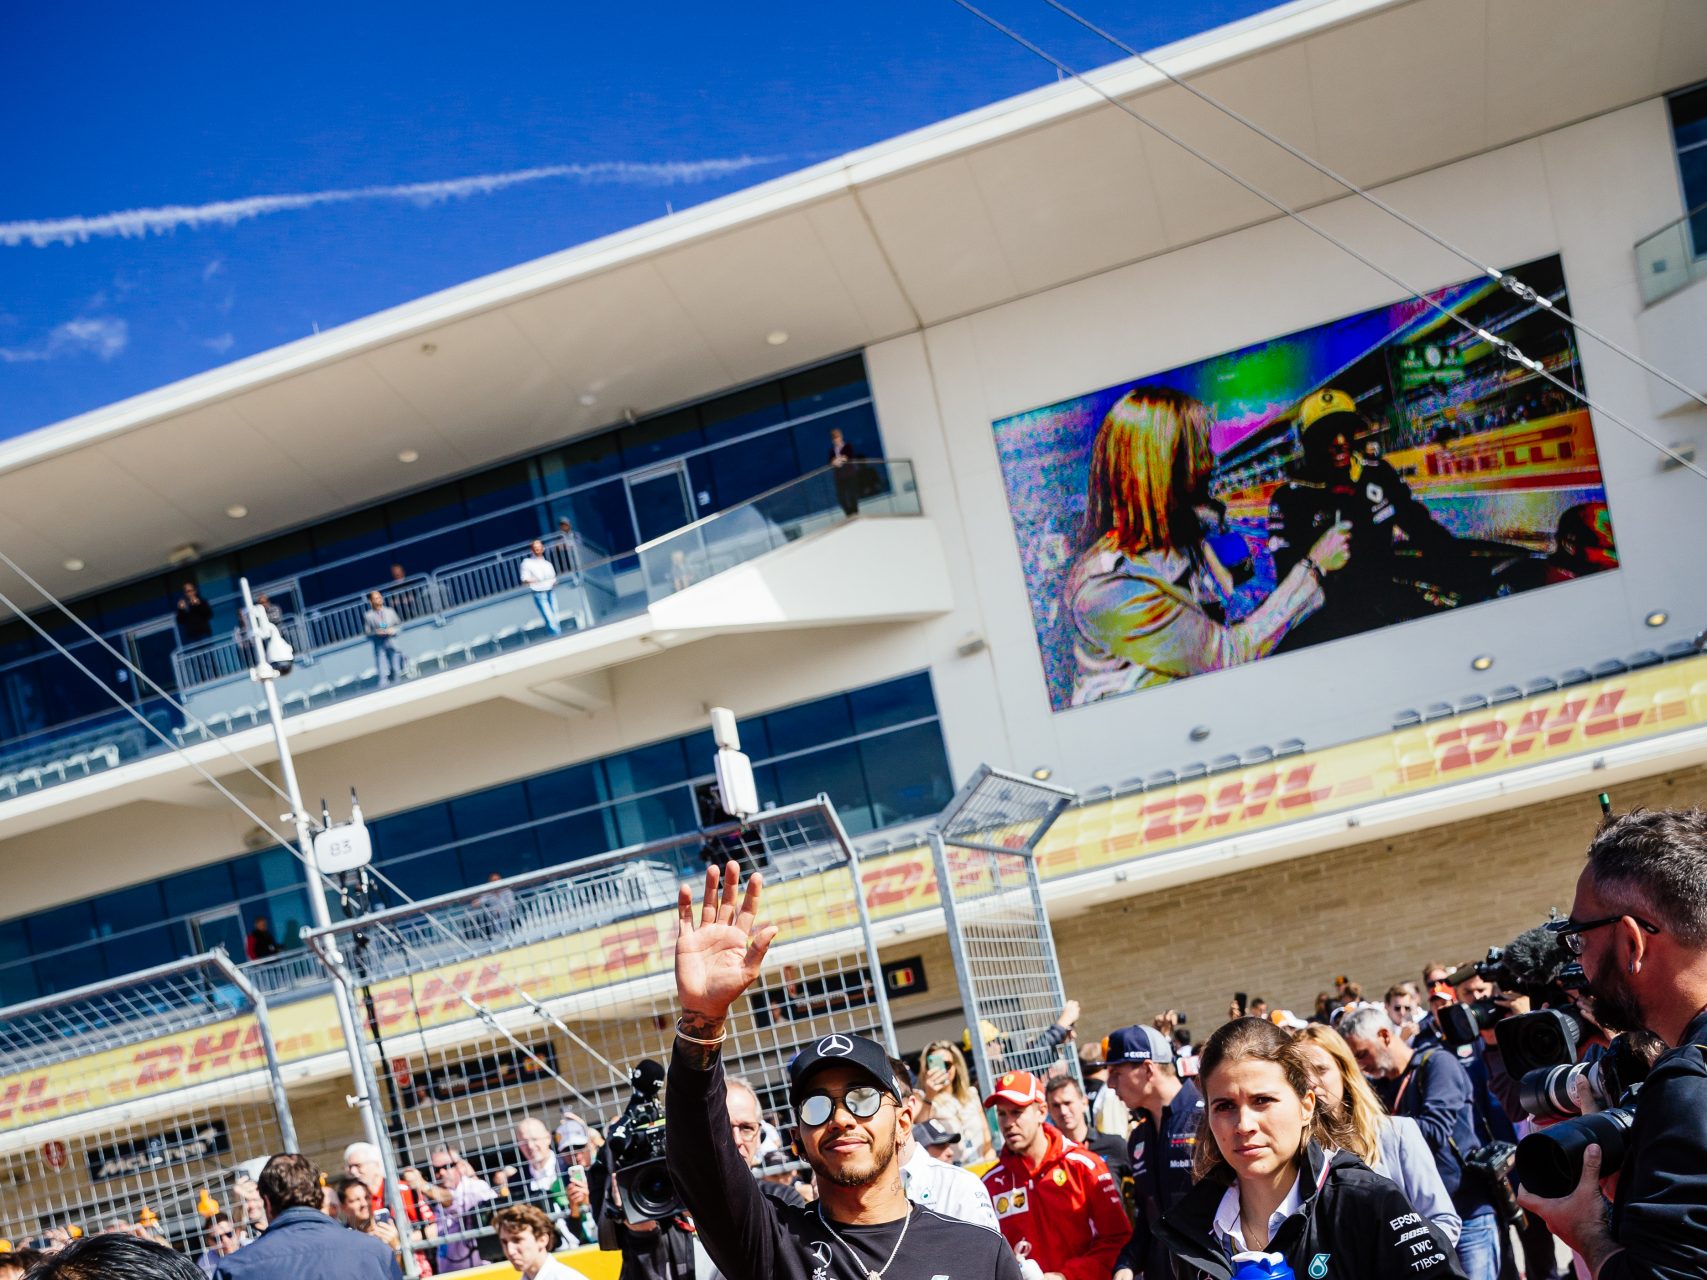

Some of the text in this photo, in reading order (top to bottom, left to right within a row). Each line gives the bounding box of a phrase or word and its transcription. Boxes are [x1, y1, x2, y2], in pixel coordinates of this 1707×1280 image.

[1435, 687, 1646, 772] DHL
[1138, 763, 1333, 844] DHL
[1390, 1212, 1422, 1231] EPSON
[1395, 1226, 1430, 1244] BOSE
[1410, 1239, 1433, 1256] IWC
